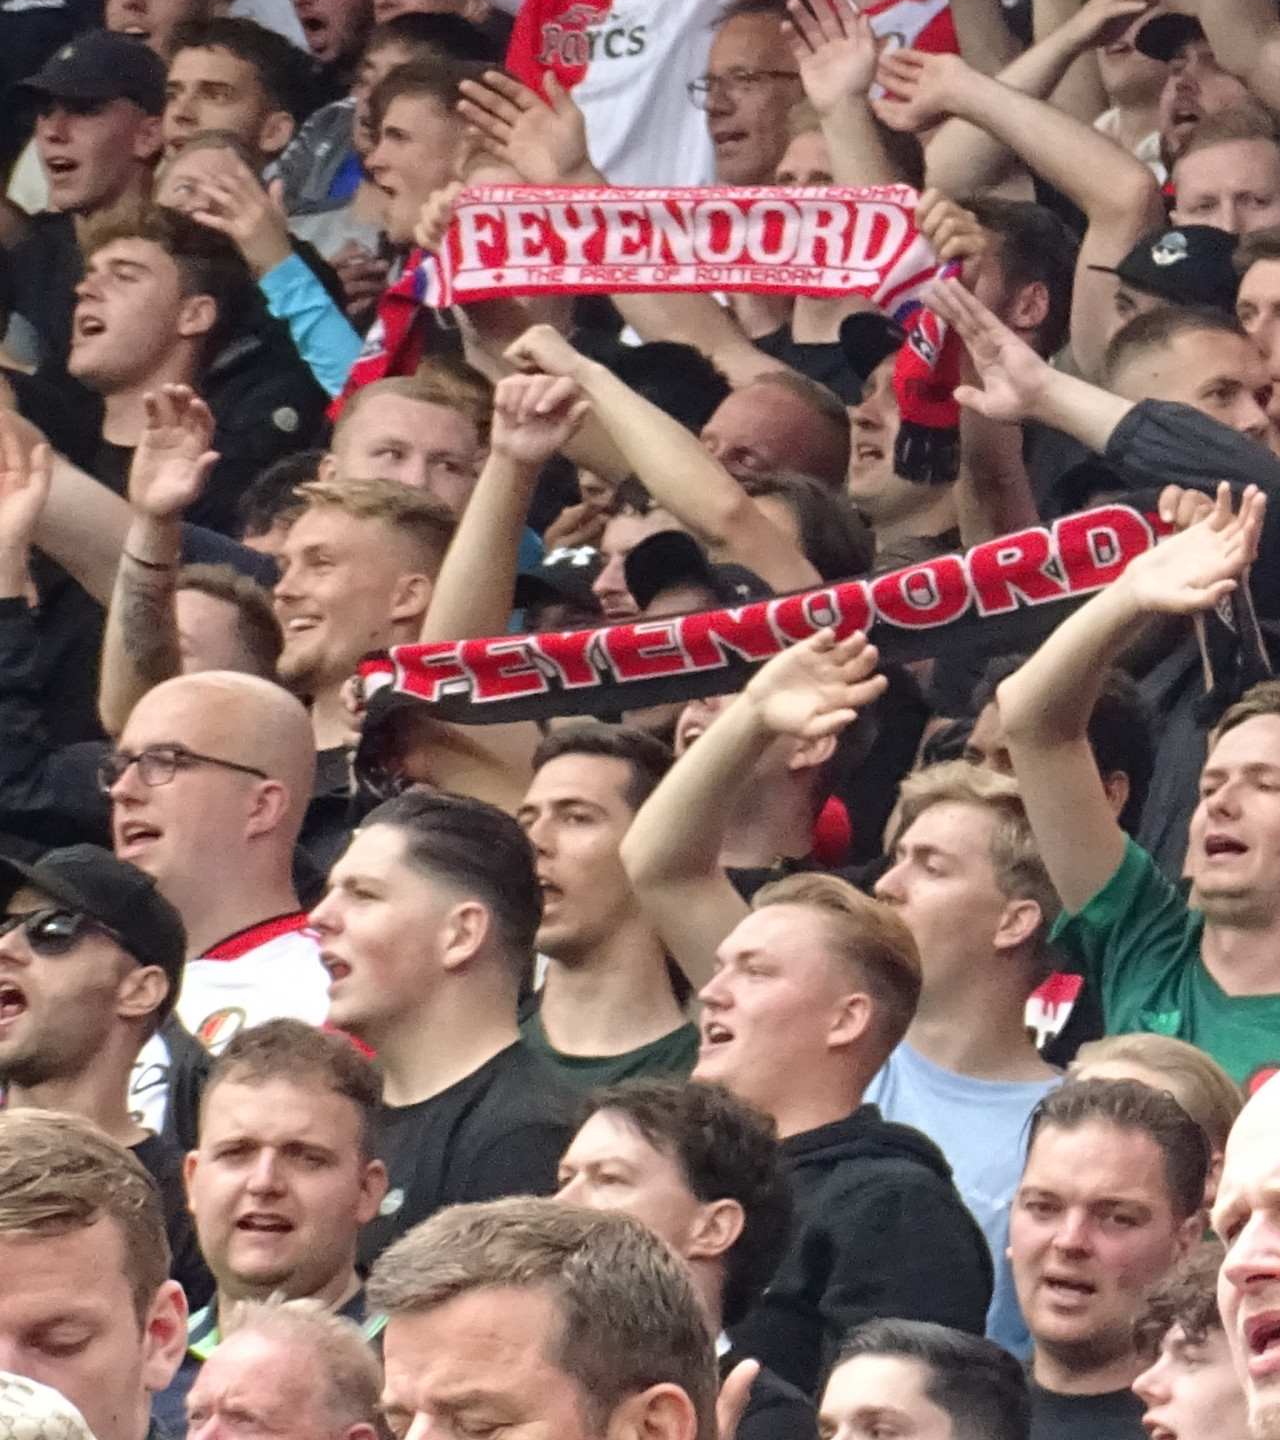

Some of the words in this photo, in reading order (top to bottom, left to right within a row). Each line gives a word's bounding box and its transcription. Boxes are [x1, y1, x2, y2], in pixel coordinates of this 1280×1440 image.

[535, 22, 646, 65] Parcs
[457, 199, 907, 269] FEYENOORD
[526, 268, 573, 284] THE
[580, 269, 638, 284] PRIDE
[653, 269, 680, 283] OF
[696, 267, 824, 285] ROTTERDAM
[391, 504, 1160, 702] FEYENOORD
